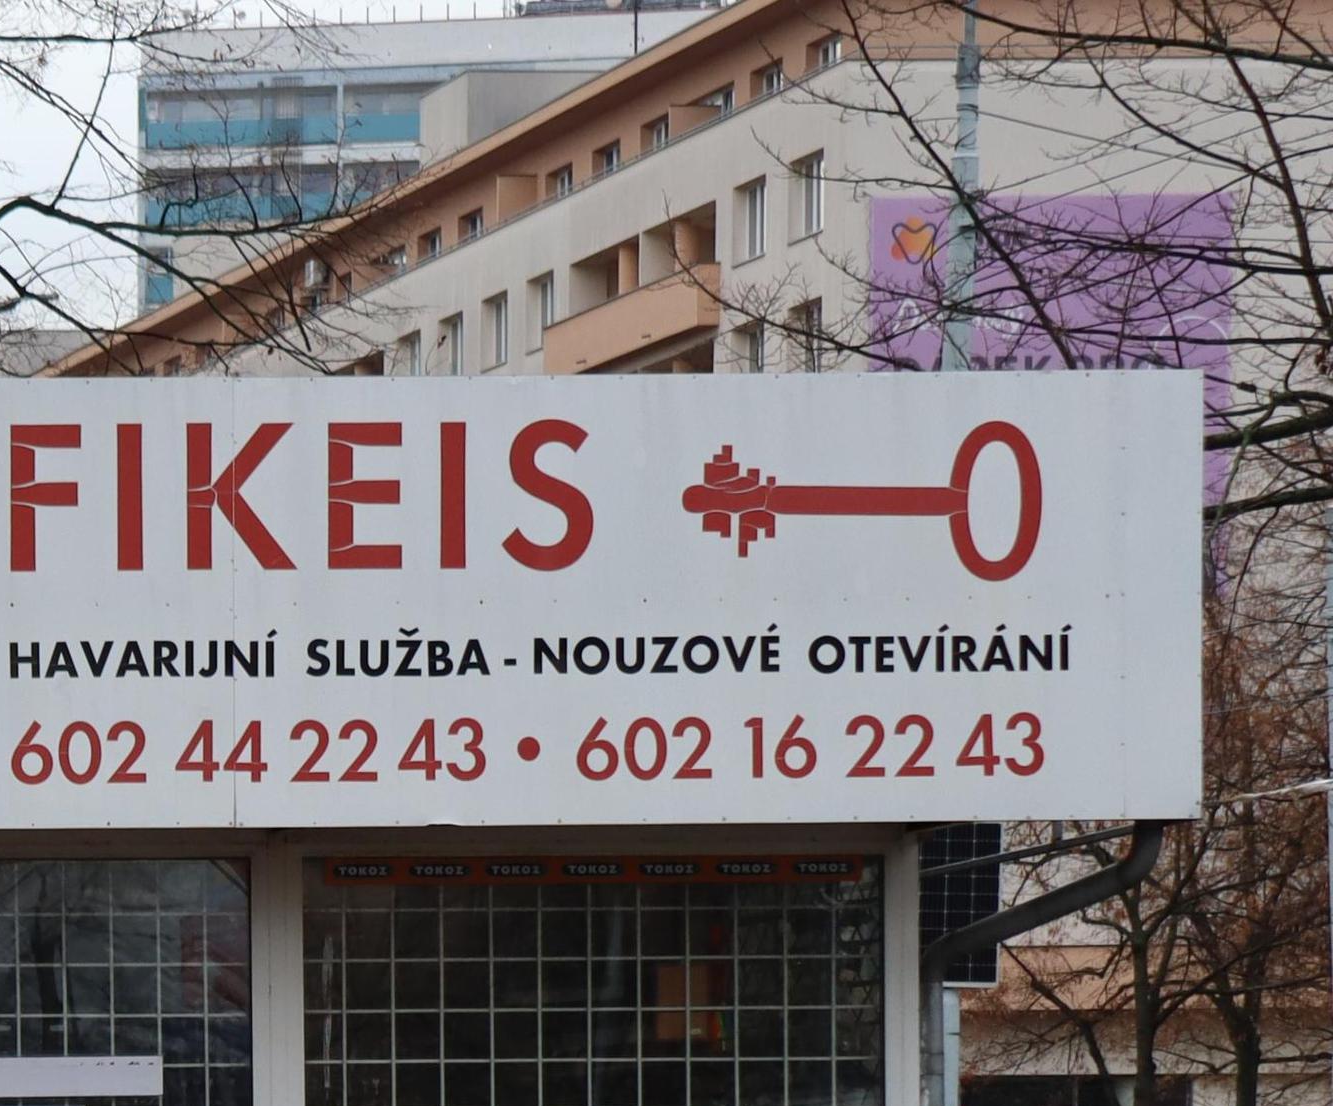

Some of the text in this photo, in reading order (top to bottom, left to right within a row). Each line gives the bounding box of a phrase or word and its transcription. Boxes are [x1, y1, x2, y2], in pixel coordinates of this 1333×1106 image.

[10, 418, 594, 572] FIKEIS
[9, 628, 277, 678] HAVARIJNÍ
[306, 627, 491, 677] SLUŽBA
[534, 623, 780, 675] NOUZOVÉ
[808, 623, 1072, 674] OTEVÍRÁNÍ
[11, 711, 1046, 785] 602 44 22 43 602 16 22 43
[339, 863, 848, 876] TOKOZ TOKOZ TOKOZ TOKOZ TOKOZ TOKOZ TOKOZ
